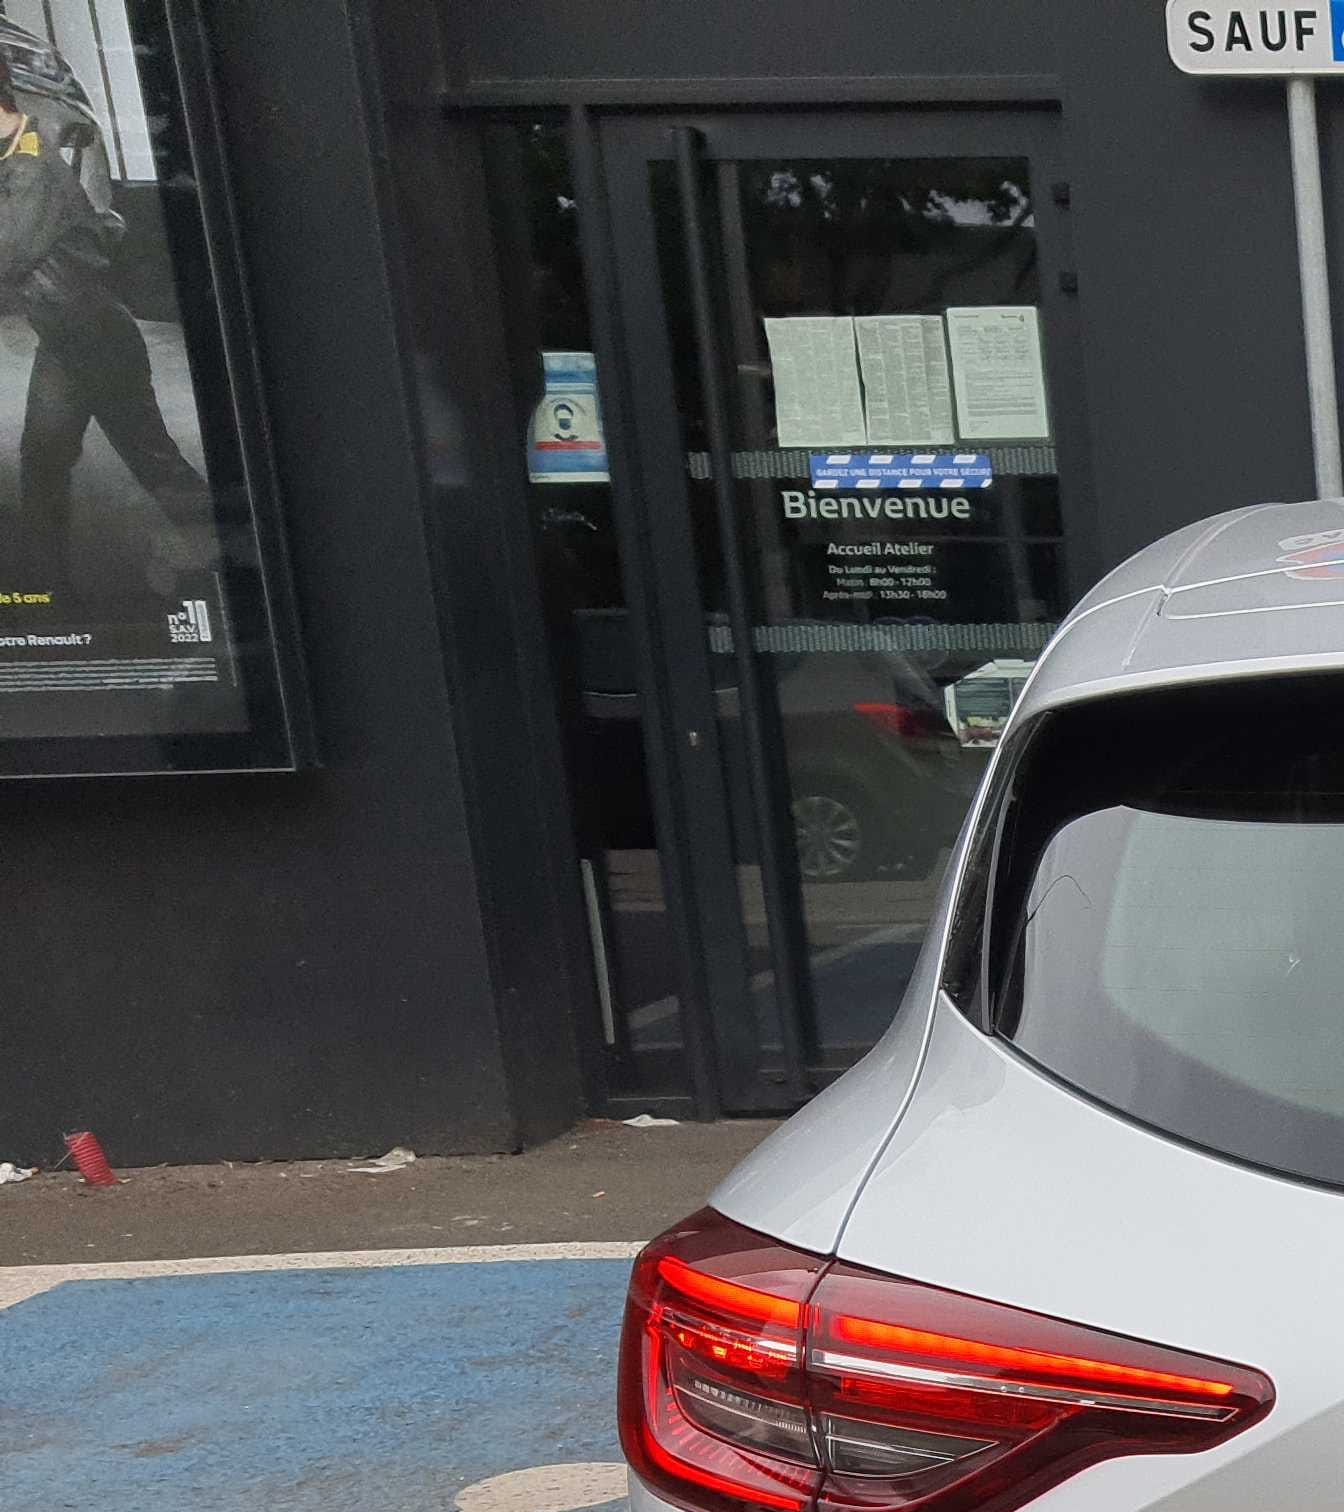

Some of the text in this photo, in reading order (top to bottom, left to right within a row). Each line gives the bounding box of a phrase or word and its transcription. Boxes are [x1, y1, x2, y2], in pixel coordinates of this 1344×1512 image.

[1188, 10, 1317, 52] SAUF
[869, 468, 907, 477] DISTANCE
[909, 468, 931, 477] POUR
[933, 468, 958, 477] VOTRE
[781, 490, 971, 519] Bienvenue
[827, 542, 934, 556] Accueil Atelier
[27, 634, 82, 646] Renault
[170, 633, 199, 643] 2022
